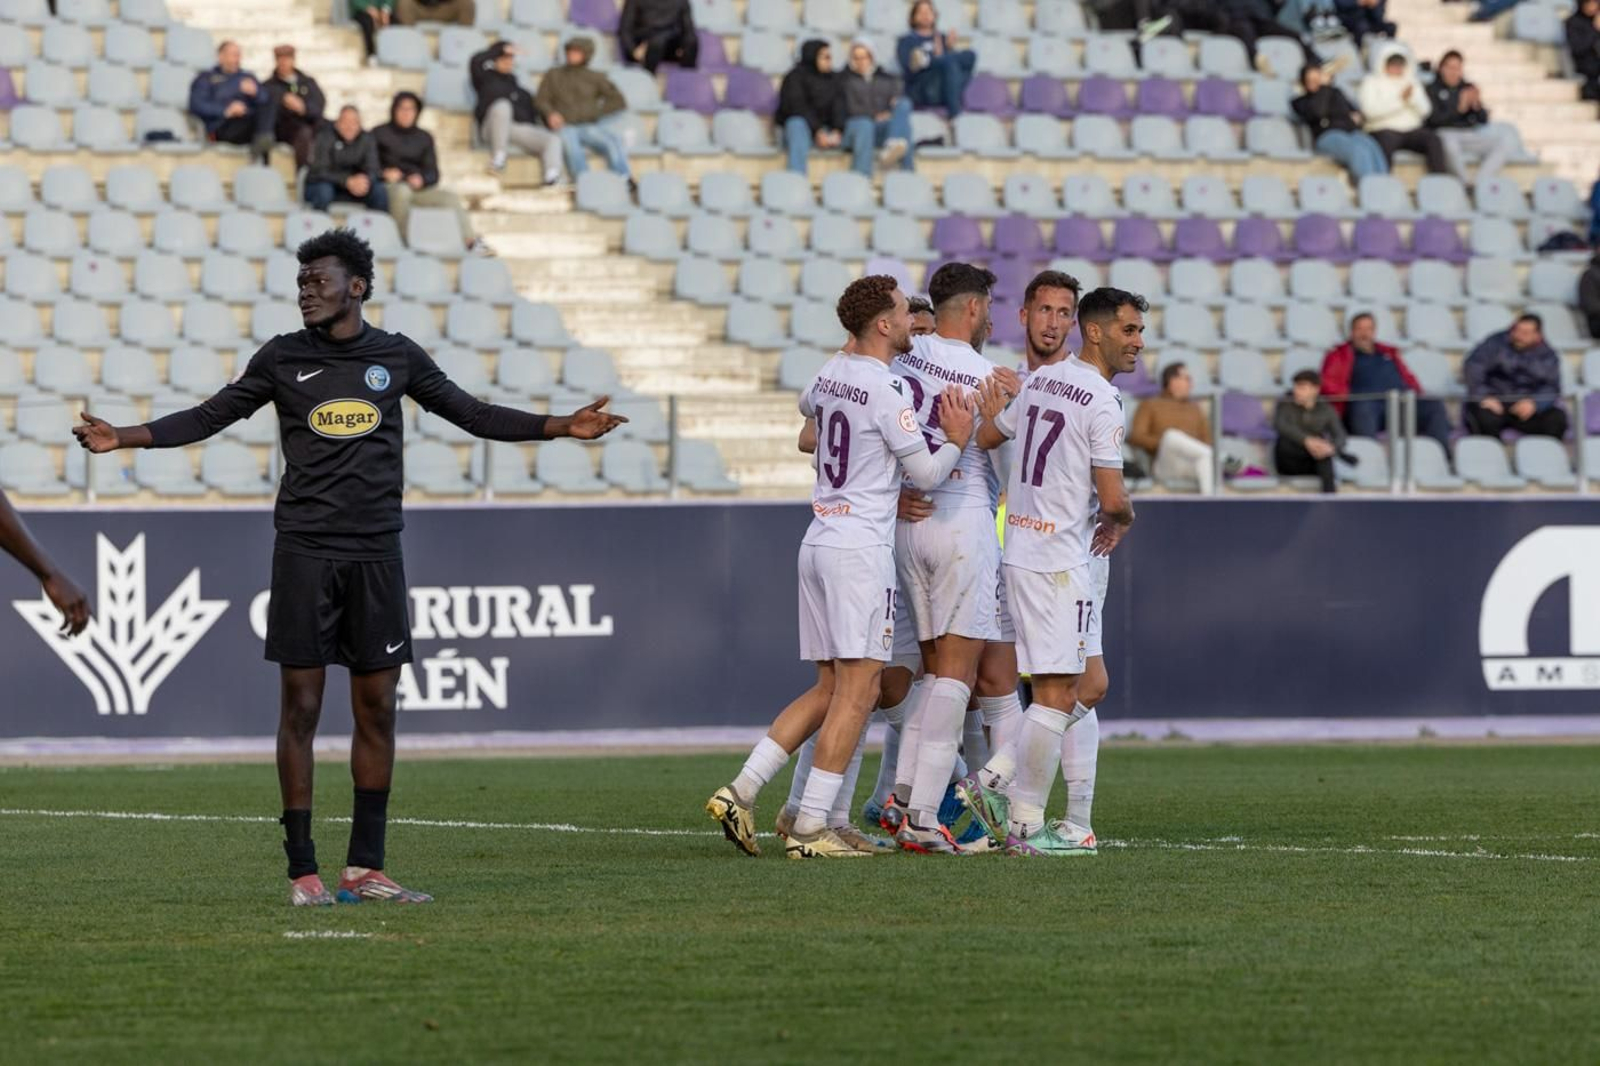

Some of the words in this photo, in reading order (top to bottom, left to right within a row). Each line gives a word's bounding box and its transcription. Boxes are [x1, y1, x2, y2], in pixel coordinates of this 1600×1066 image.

[317, 411, 374, 428] Magar
[828, 381, 868, 406] ALONSO
[1043, 378, 1093, 406] MOYANO
[815, 404, 850, 489] 19
[1021, 404, 1065, 487] 17
[408, 584, 613, 639] RURAL
[395, 648, 509, 711] AÉN
